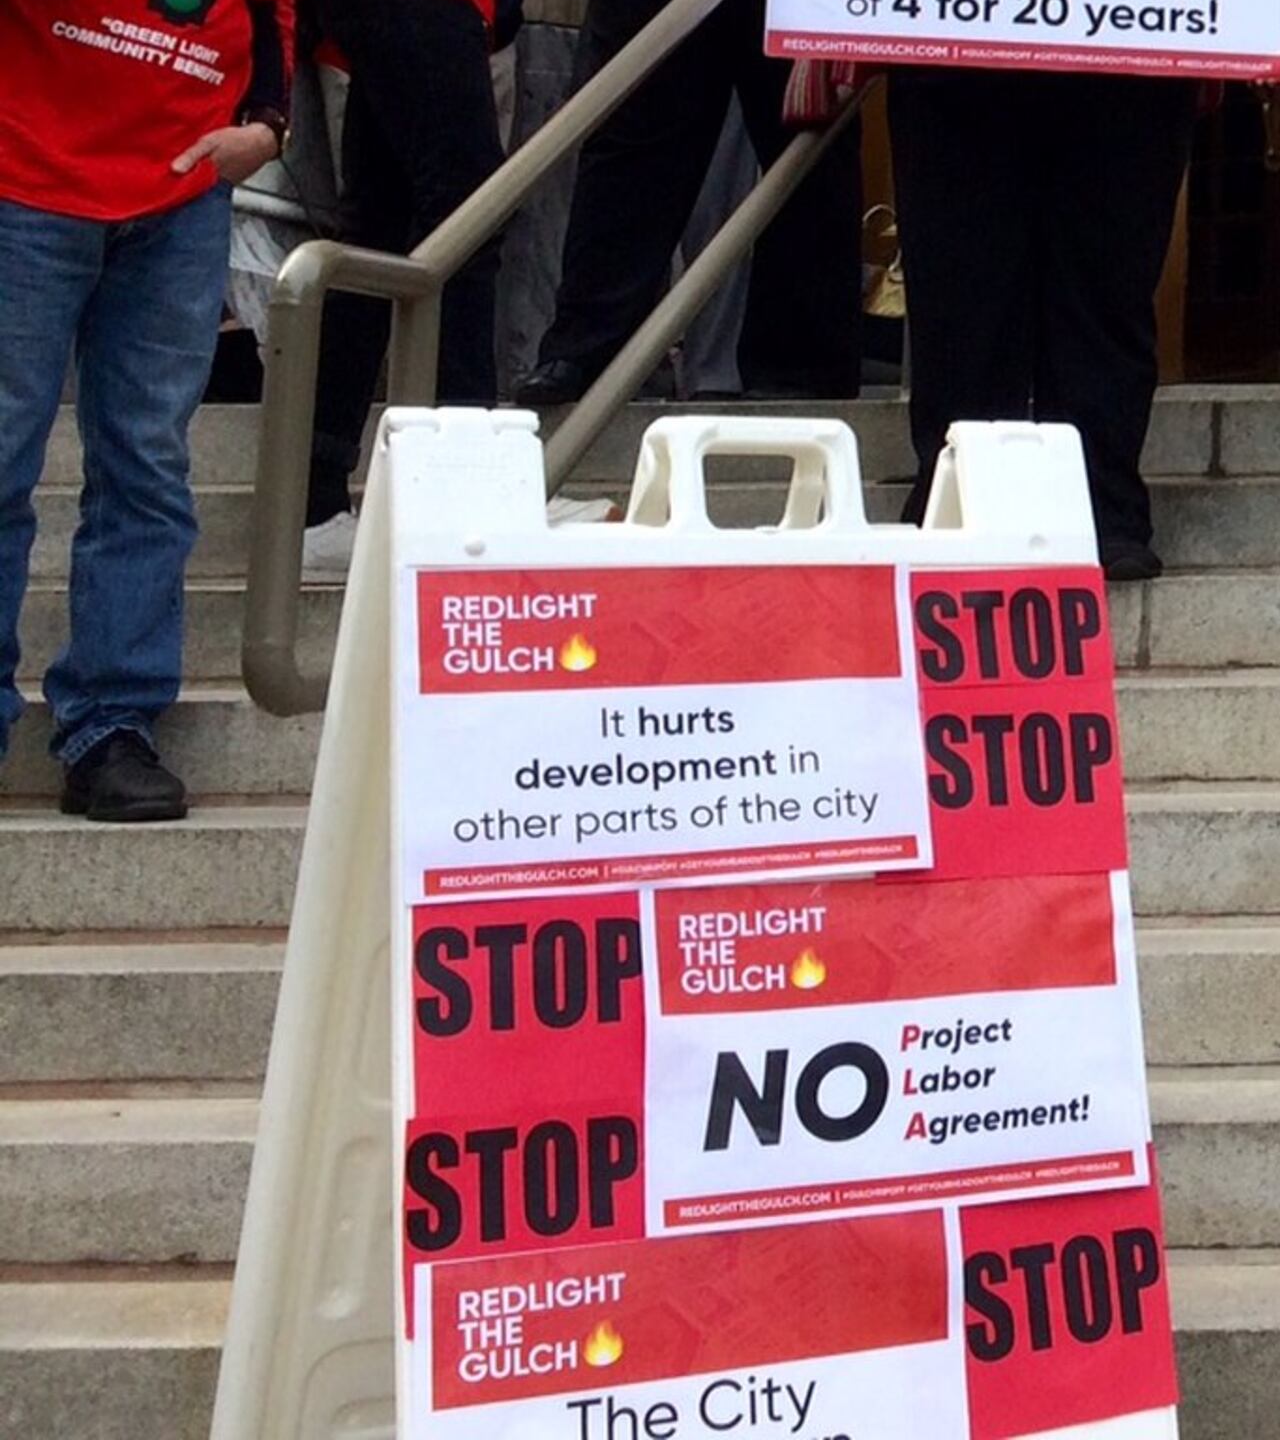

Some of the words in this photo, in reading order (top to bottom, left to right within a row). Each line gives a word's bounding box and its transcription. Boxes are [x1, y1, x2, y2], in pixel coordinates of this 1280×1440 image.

[51, 21, 172, 66] COMMUNITY
[178, 40, 220, 64] LIGHT
[443, 594, 598, 622] REDLIGHT
[443, 621, 502, 649] THE
[915, 586, 1102, 684] STOP
[443, 645, 555, 675] GULCH
[601, 707, 626, 739] It
[639, 705, 735, 737] hurts
[514, 748, 778, 792] development
[788, 745, 821, 775] in
[925, 712, 1113, 810] STOP
[453, 808, 562, 844] other
[576, 800, 678, 840] parts
[691, 794, 729, 832] of
[738, 789, 802, 826] the
[812, 786, 880, 824] city
[678, 906, 827, 941] REDLIGHT
[679, 941, 737, 967] THE
[415, 917, 642, 1039] STOP
[681, 964, 787, 995] GULCH
[702, 1041, 890, 1153] NO
[900, 1017, 1013, 1056] Project
[902, 1064, 996, 1097] Labor
[904, 1094, 1091, 1145] Agreement!
[406, 1114, 638, 1255] STOP
[458, 1271, 626, 1320] REDLIGHT
[962, 1227, 1161, 1364] STOP
[458, 1319, 524, 1349] THE
[459, 1341, 579, 1384] GULCH
[566, 1395, 679, 1440] The
[699, 1375, 817, 1434] City
